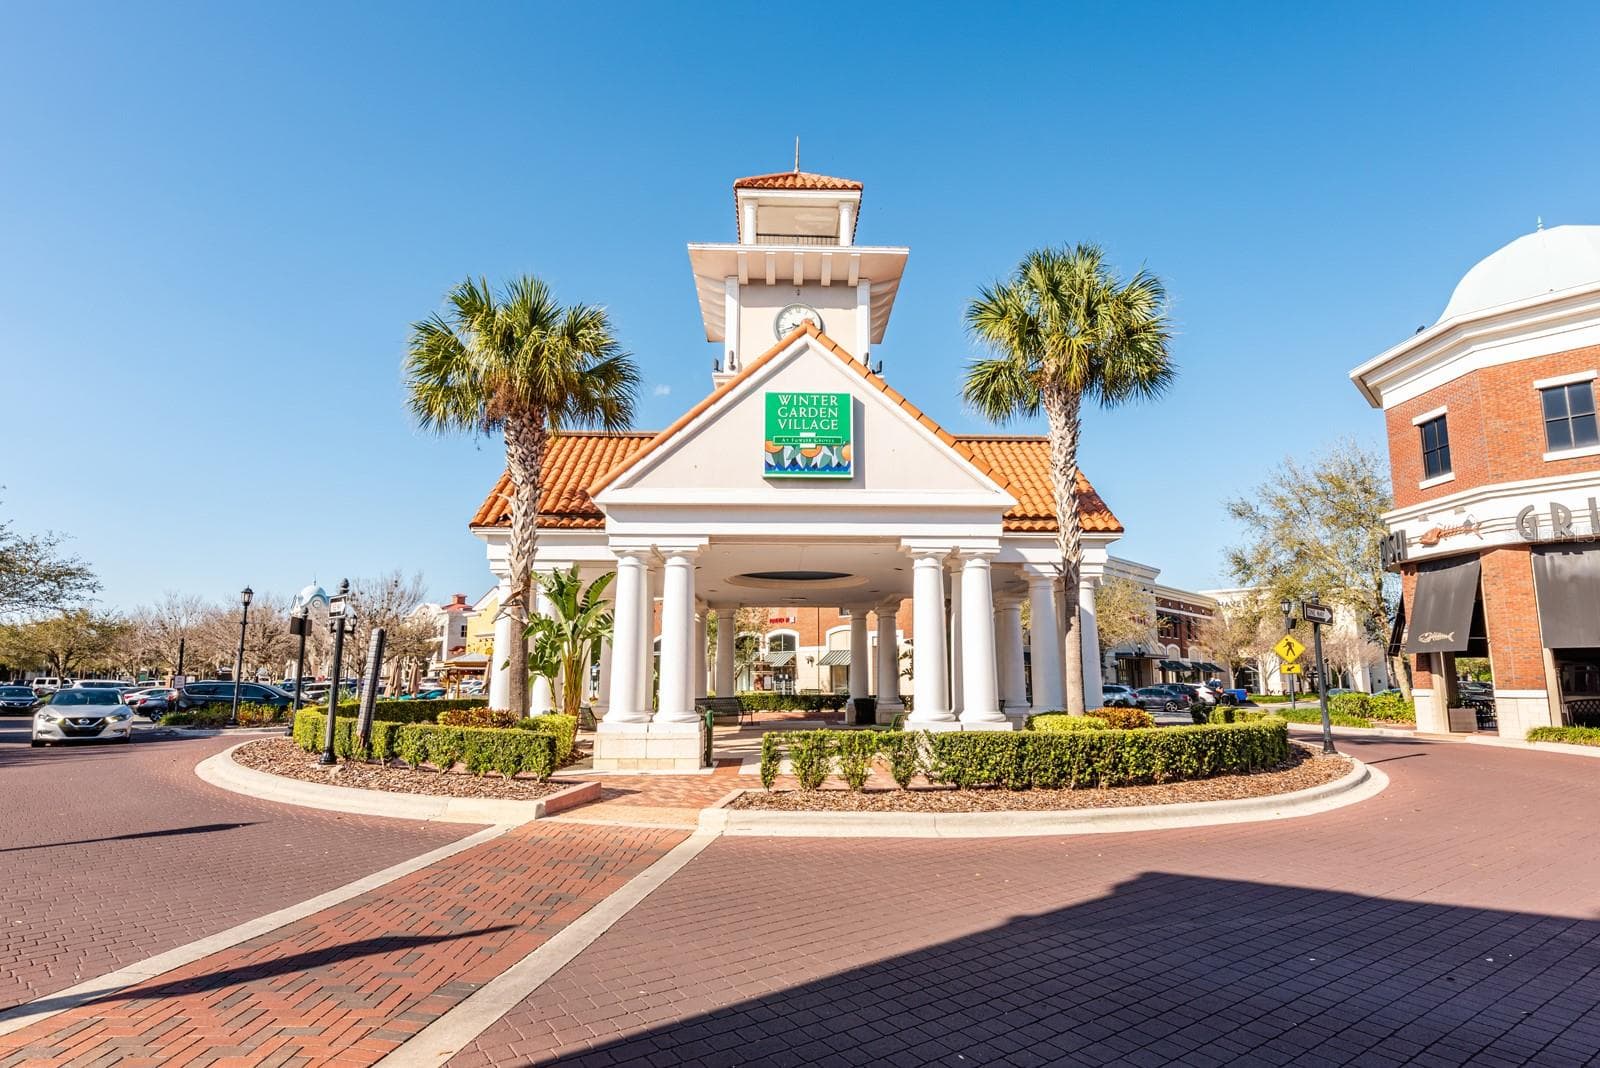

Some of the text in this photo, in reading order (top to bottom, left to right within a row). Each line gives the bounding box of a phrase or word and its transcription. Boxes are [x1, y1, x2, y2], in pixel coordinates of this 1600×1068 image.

[778, 394, 839, 406] WINTER
[777, 407, 838, 418] GARDEN
[777, 419, 839, 430] VILLAGE
